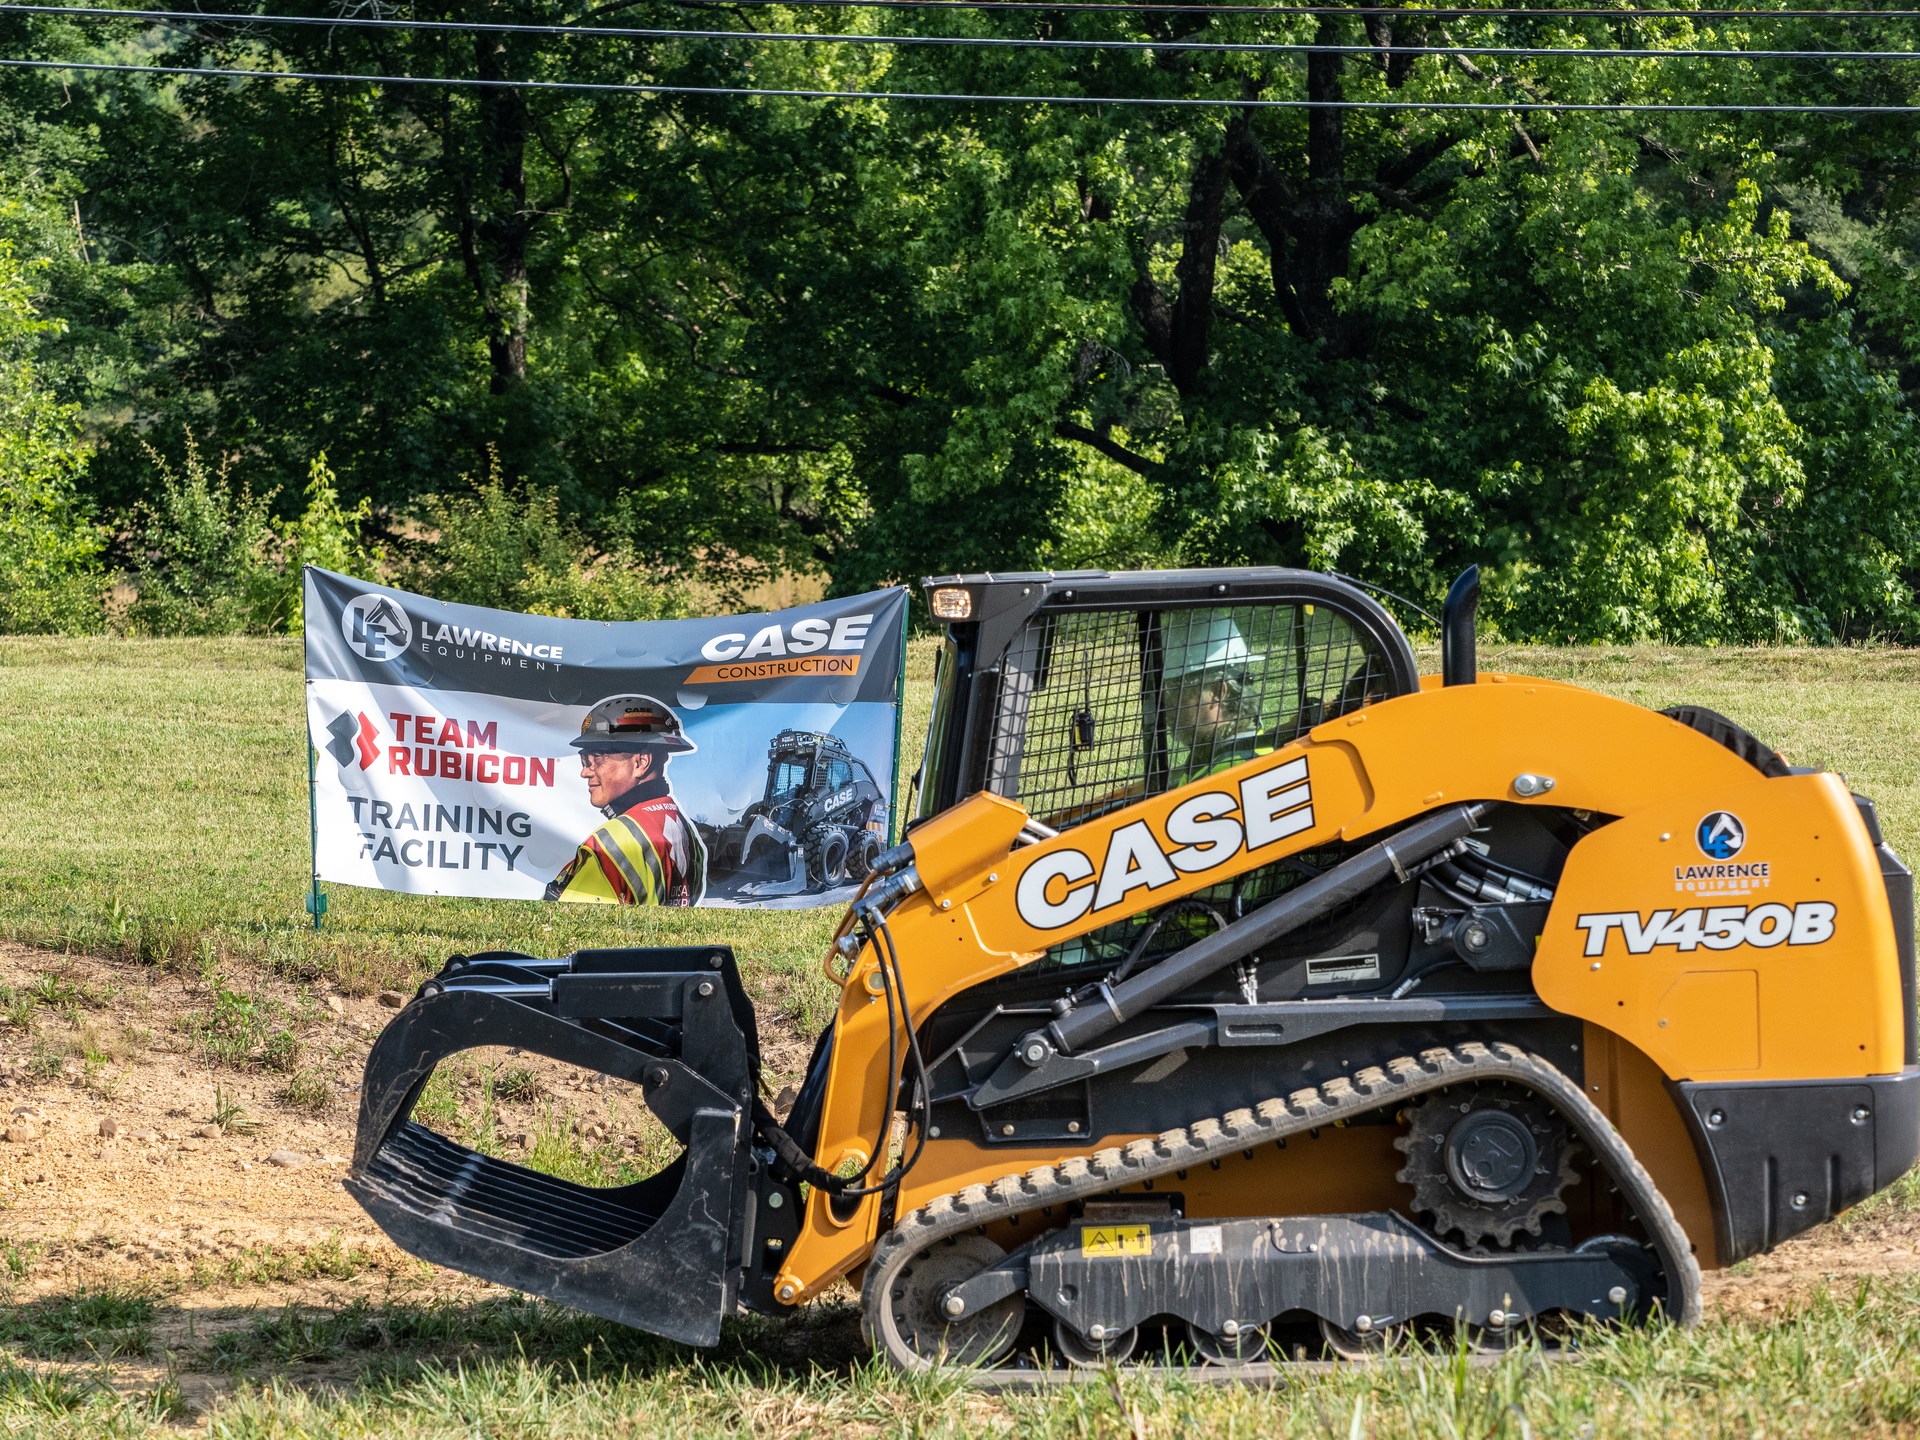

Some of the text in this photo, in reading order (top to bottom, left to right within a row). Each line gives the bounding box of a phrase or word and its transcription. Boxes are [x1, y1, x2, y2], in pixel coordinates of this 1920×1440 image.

[421, 621, 563, 659] LAWRENCE
[701, 614, 874, 662] CASE
[422, 643, 562, 673] EQUIPMENT
[717, 658, 853, 679] CONSTRUCTION
[389, 712, 498, 750] TEAM
[389, 745, 555, 787] RUBICON
[347, 796, 532, 837] TRAINING
[824, 788, 853, 812] CASE
[356, 832, 525, 872] FACILITY
[1015, 754, 1316, 930] CASE
[1675, 863, 1769, 880] LAWRENCE
[1675, 879, 1770, 891] EQUIPMENT
[1575, 901, 1837, 957] TV450B
